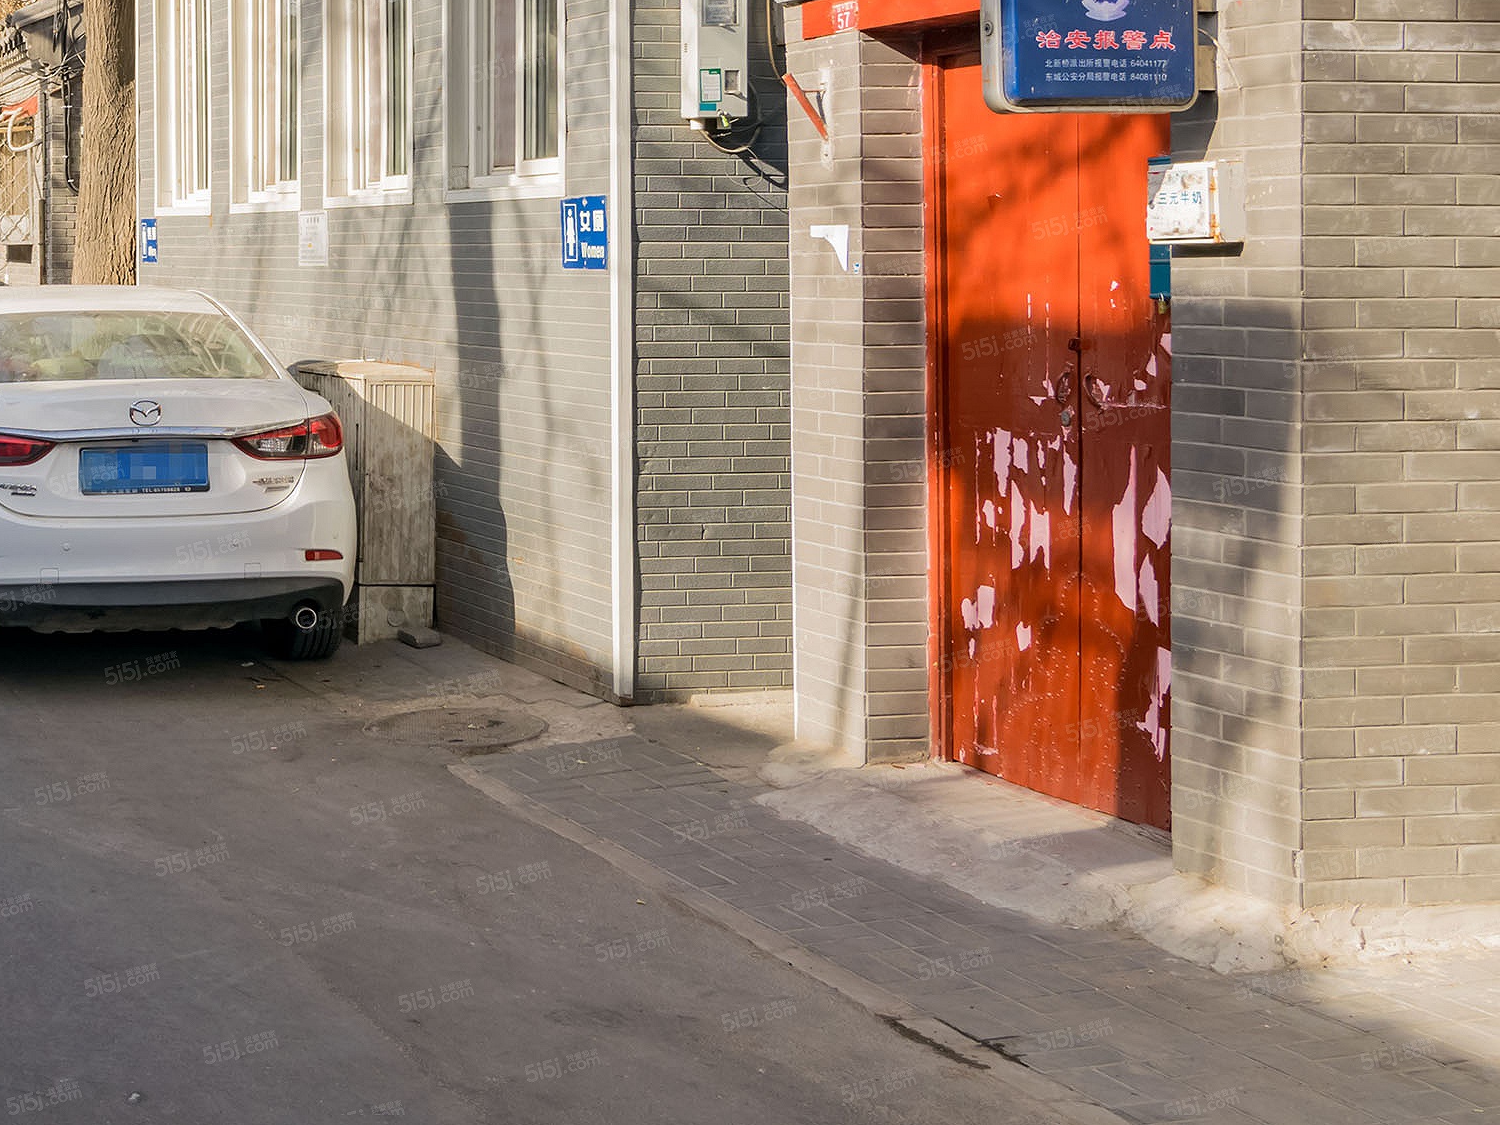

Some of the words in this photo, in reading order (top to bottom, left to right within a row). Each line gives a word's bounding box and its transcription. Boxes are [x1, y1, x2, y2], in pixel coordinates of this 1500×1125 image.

[837, 11, 851, 29] 57
[1036, 30, 1176, 51] 治安报警点
[1157, 190, 1202, 205] 三元牛奶
[580, 242, 605, 259] Women
